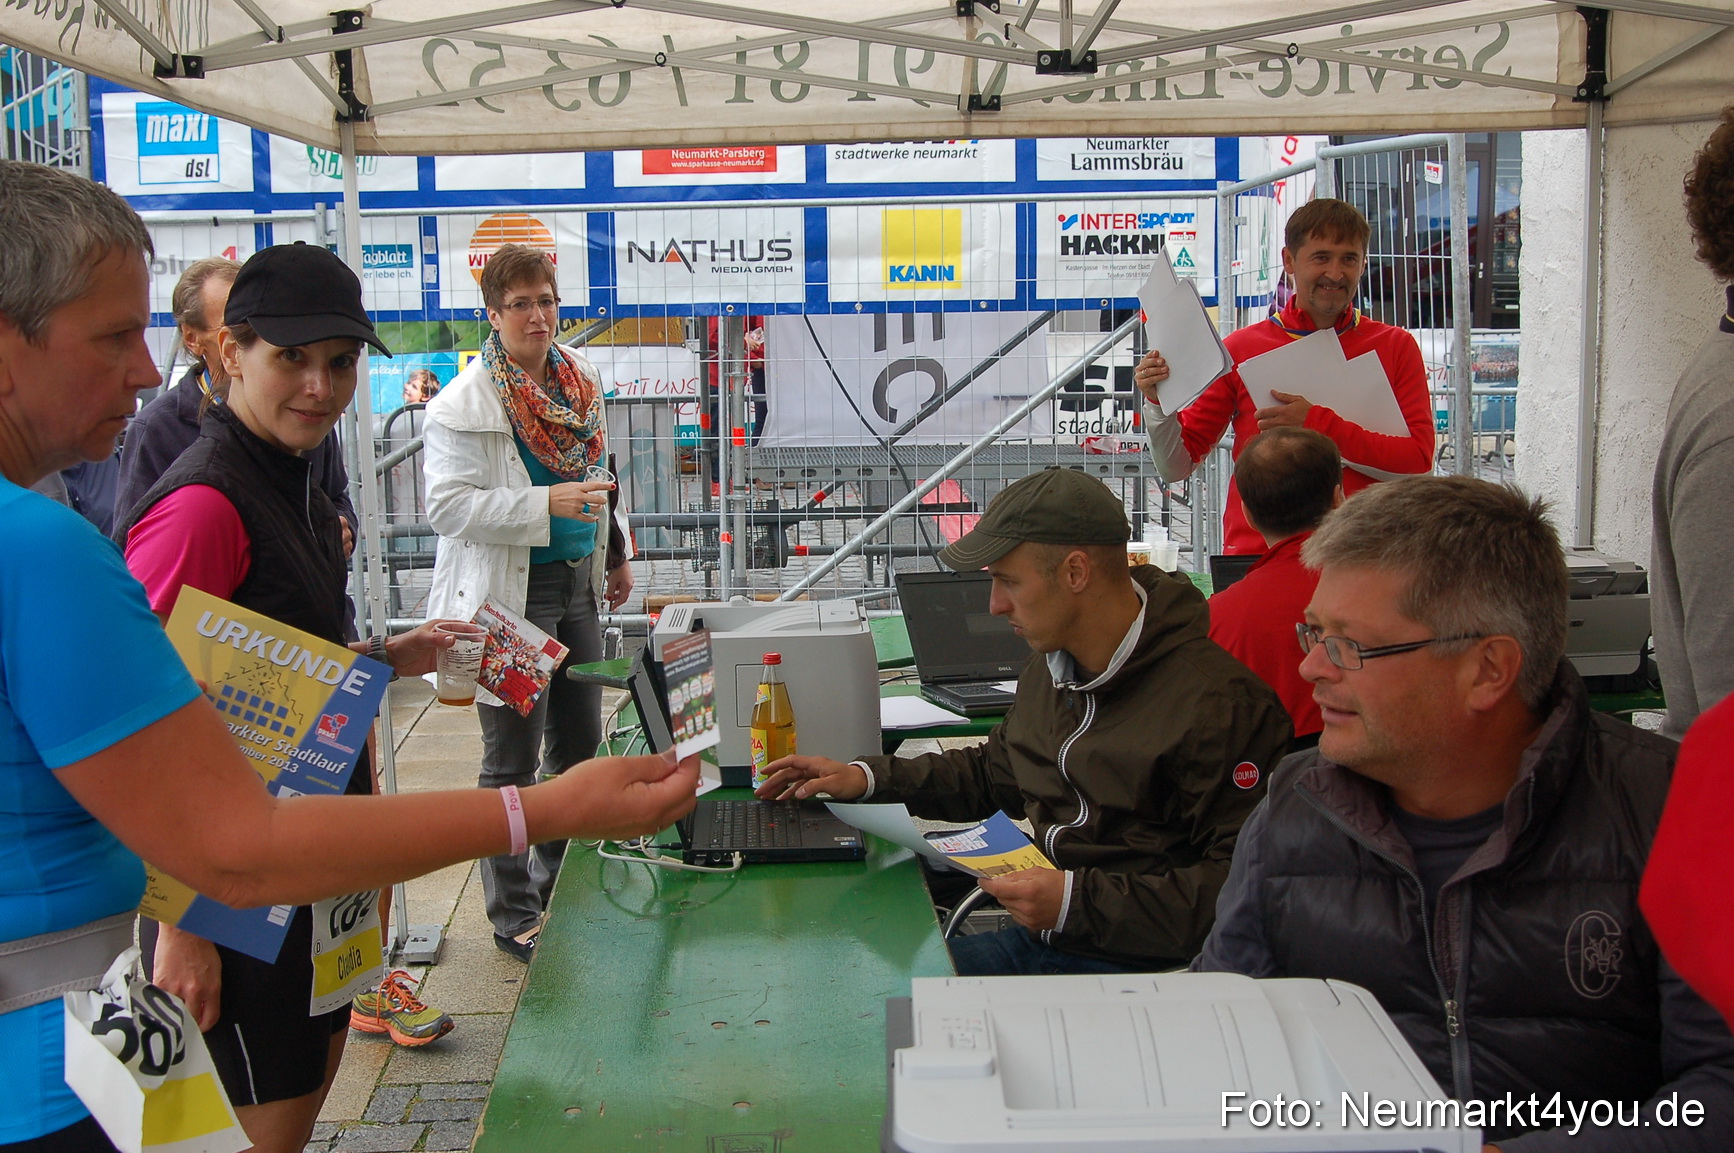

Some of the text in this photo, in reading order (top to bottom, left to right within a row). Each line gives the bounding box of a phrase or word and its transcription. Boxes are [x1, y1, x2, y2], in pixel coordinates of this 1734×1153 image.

[145, 112, 210, 144] maxi
[671, 147, 766, 161] Neumarkt-Parsberg
[834, 147, 978, 161] stadtwerke neumarkt
[1086, 138, 1170, 151] Neumarkter
[185, 158, 211, 179] dsl
[671, 158, 765, 169] www.sparkasse-neumarkt.de
[1071, 153, 1184, 171] Lammsbräu
[627, 237, 793, 273] NATHUS
[1061, 234, 1166, 256] HACKN
[711, 265, 793, 274] MEDIA GMBH
[889, 264, 955, 283] KANN
[483, 603, 518, 631] Bestellkarte
[196, 610, 372, 697] URKUNDE
[222, 719, 274, 747] arkter
[273, 739, 348, 775] Stadtlauf
[240, 745, 299, 774] mber 2013
[1235, 770, 1257, 781] COLMAR
